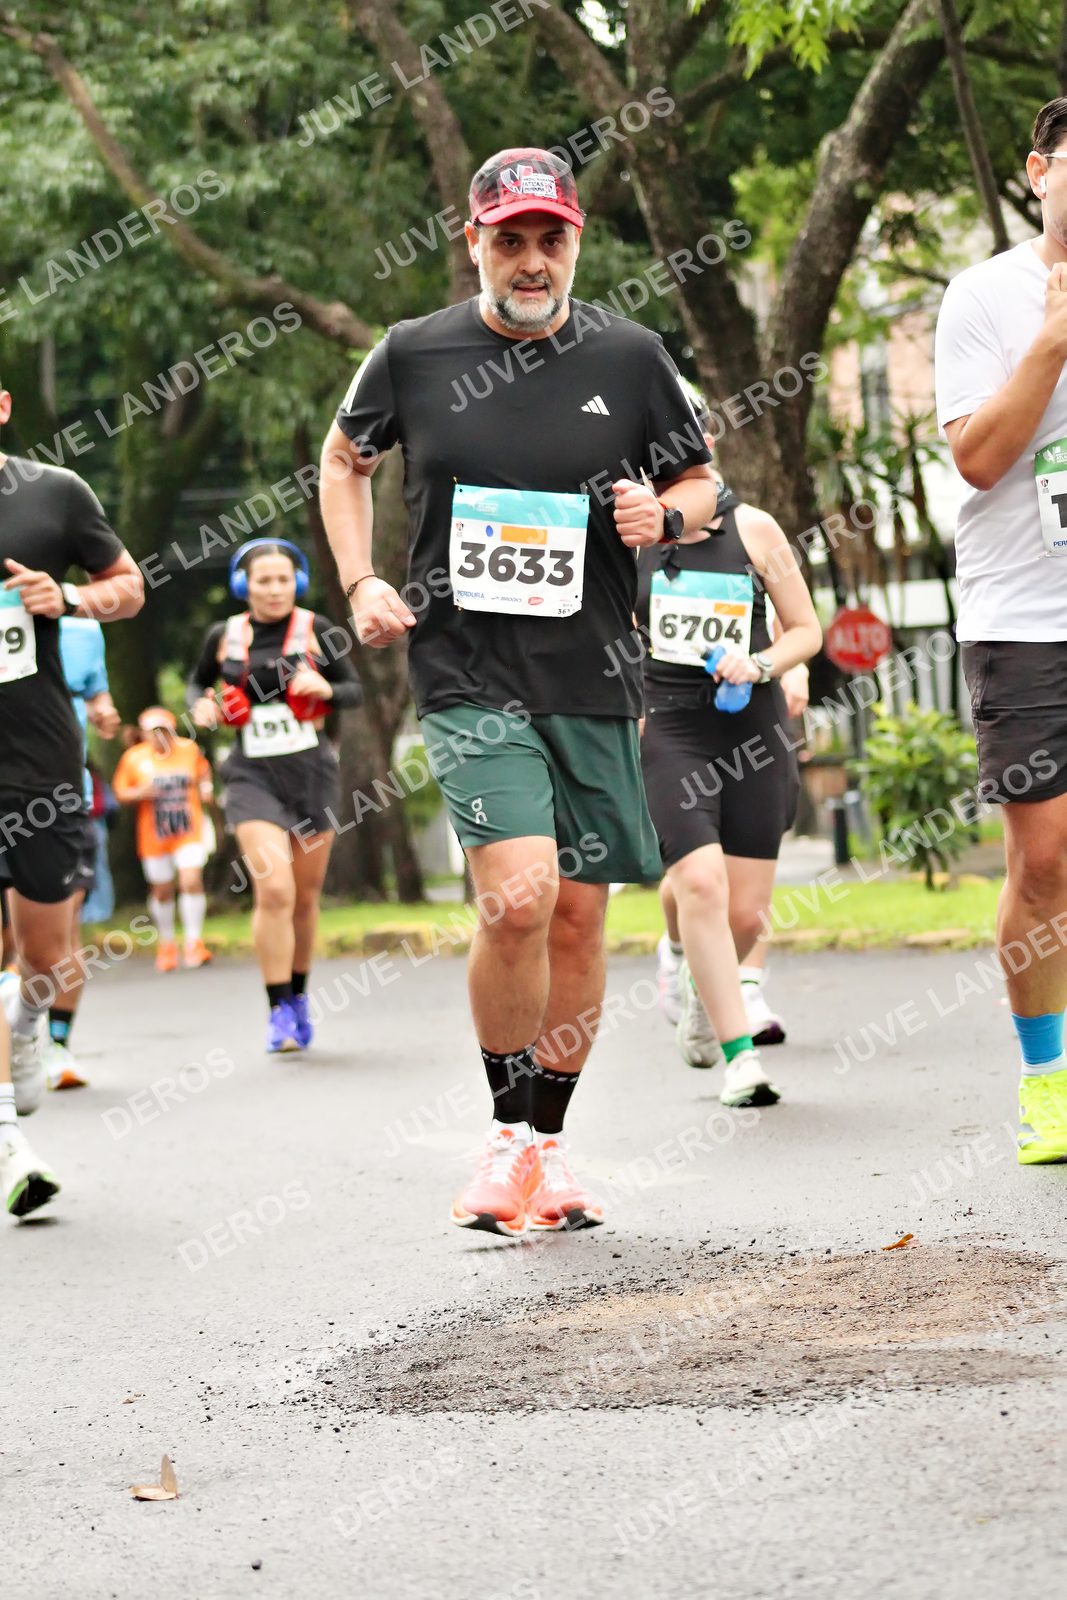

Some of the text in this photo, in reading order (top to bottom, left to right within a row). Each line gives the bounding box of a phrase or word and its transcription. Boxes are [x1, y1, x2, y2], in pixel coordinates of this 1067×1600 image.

[457, 541, 575, 586] 3633
[0, 627, 26, 654] 9
[659, 613, 743, 644] 6704
[832, 623, 887, 655] ALTO
